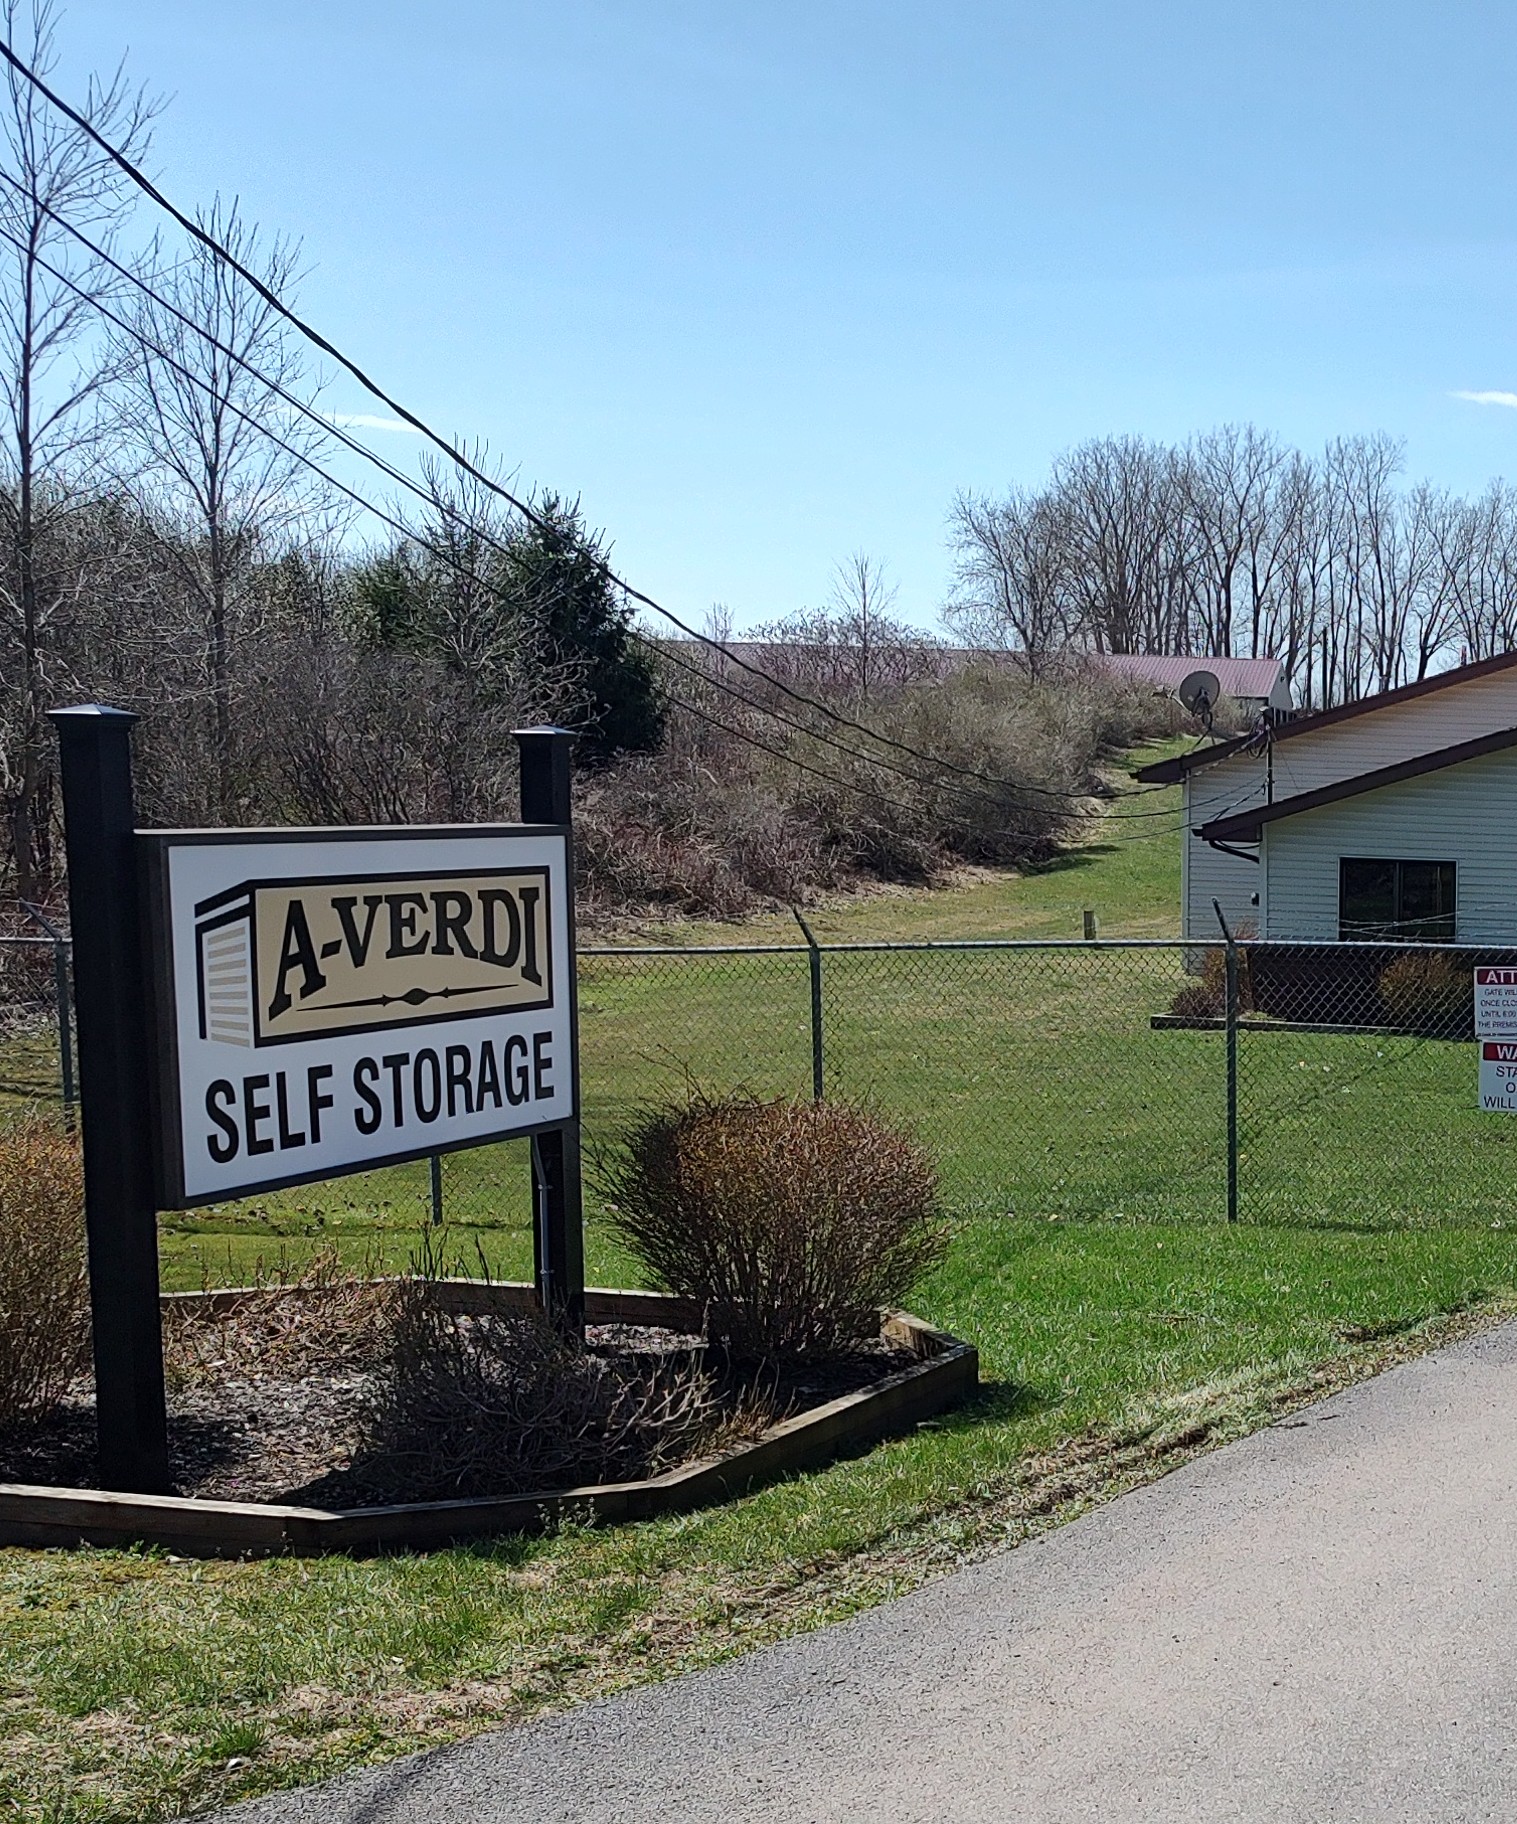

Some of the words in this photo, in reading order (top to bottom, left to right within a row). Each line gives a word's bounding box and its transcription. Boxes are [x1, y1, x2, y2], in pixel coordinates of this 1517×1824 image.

[268, 886, 542, 1022] A-VERDI
[1484, 988, 1502, 996] GATE
[1480, 999, 1500, 1007] ONCE
[1481, 1010, 1501, 1018] UNTIL
[1478, 1020, 1491, 1028] THE
[205, 1063, 334, 1164] SELF
[353, 1030, 555, 1135] STORAGE
[1484, 1095, 1515, 1109] WILL
